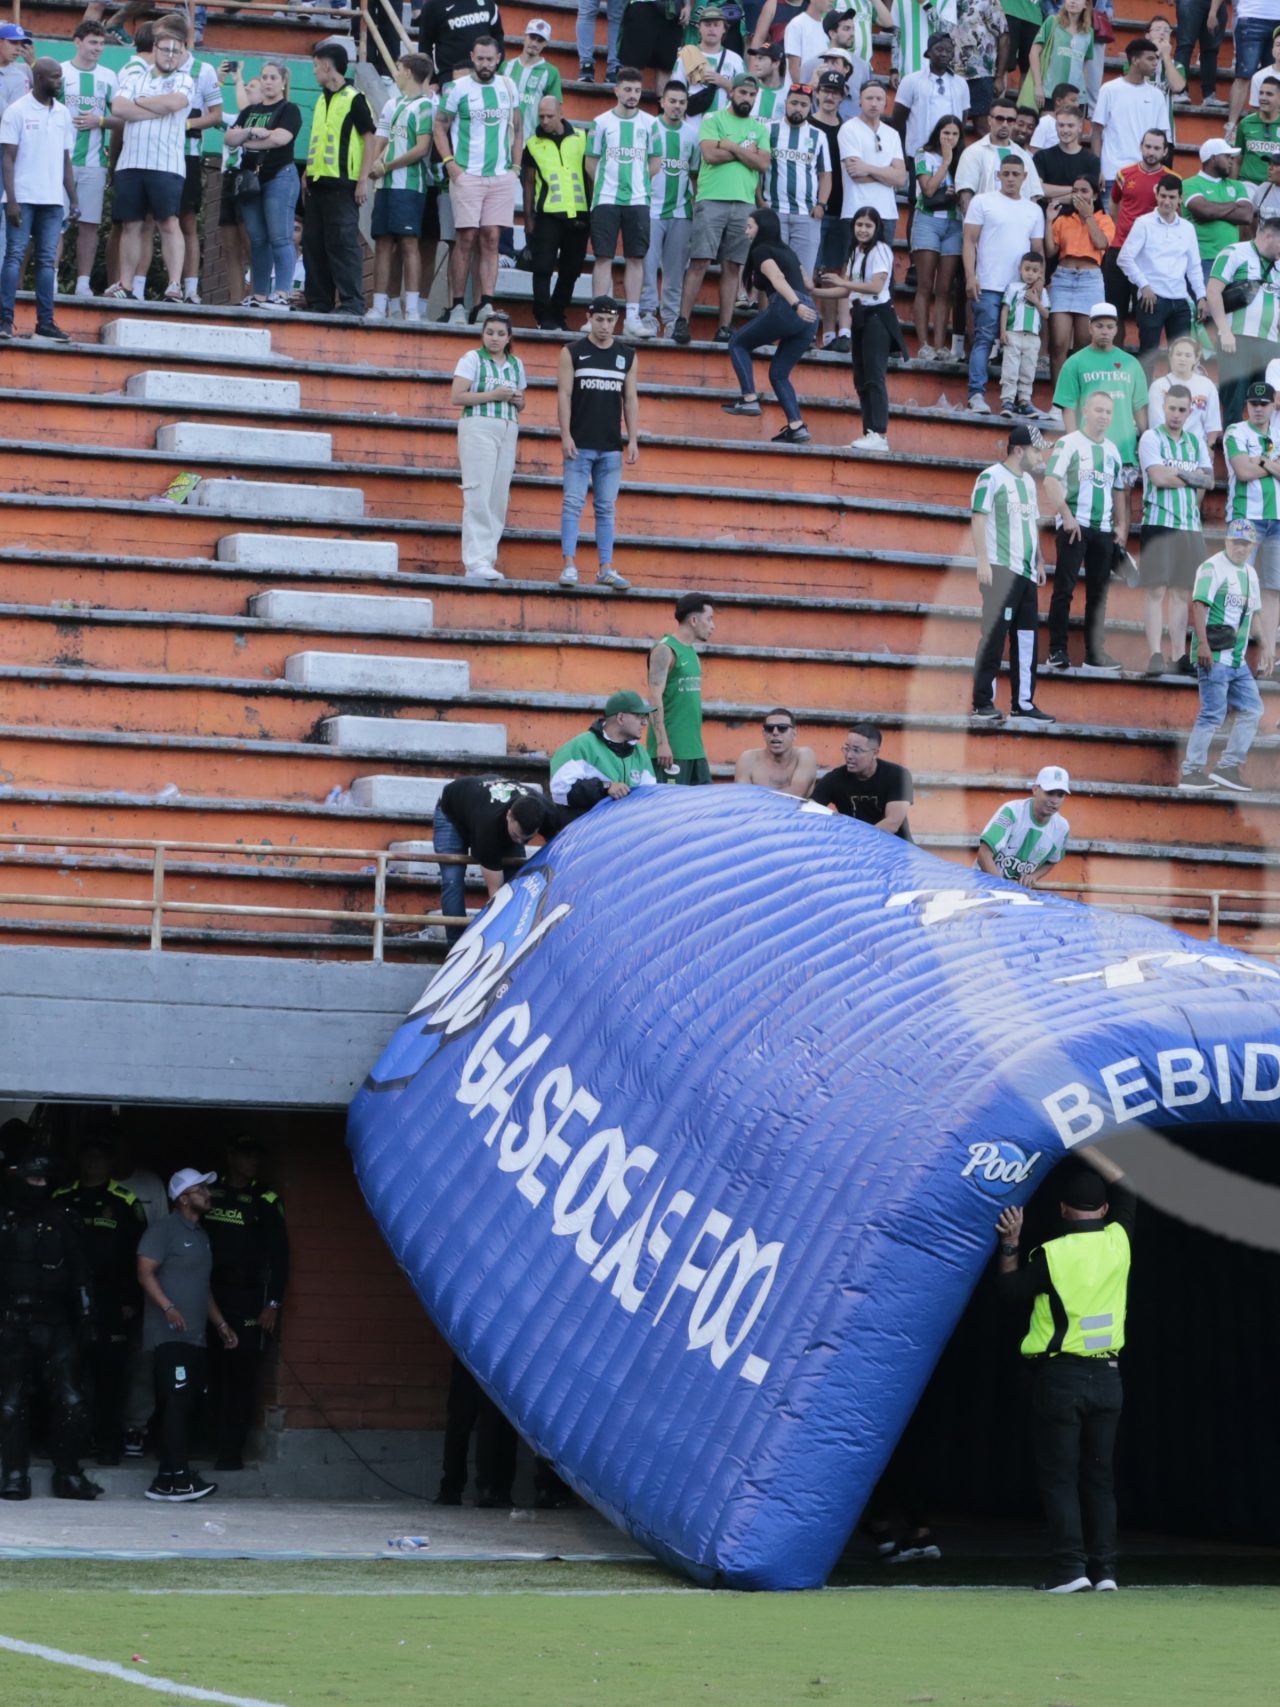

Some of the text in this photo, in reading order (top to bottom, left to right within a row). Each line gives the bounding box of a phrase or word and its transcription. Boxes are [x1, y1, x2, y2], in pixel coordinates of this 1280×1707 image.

[447, 11, 491, 30] POSTOBON
[580, 379, 624, 392] POSTOBON
[960, 1140, 1042, 1185] Pool
